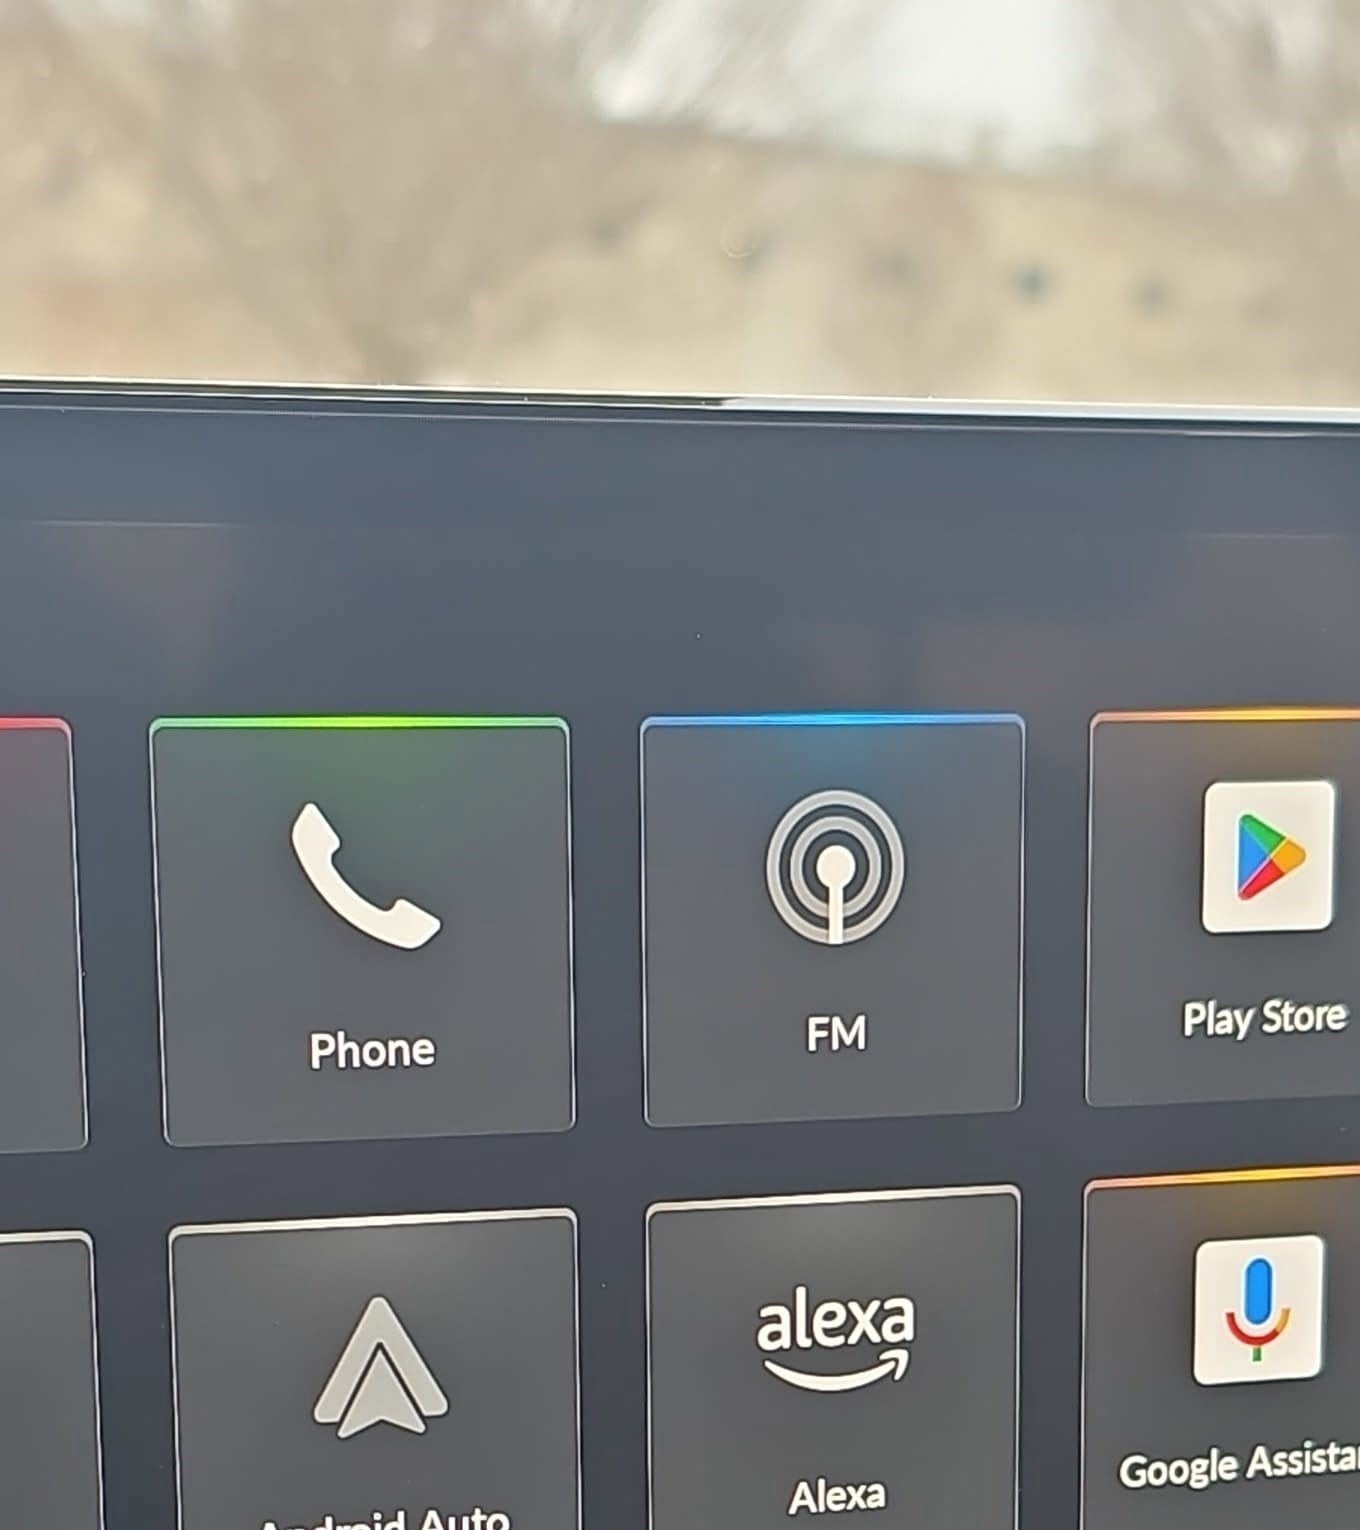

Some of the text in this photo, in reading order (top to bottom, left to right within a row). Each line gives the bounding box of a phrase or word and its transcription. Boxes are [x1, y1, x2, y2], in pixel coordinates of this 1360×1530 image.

[807, 1014, 867, 1053] FM
[1183, 998, 1348, 1042] Play Store
[310, 1030, 436, 1070] Phone
[756, 1286, 916, 1351] alexa
[1119, 1446, 1239, 1490] Google
[787, 1477, 887, 1516] Alexa
